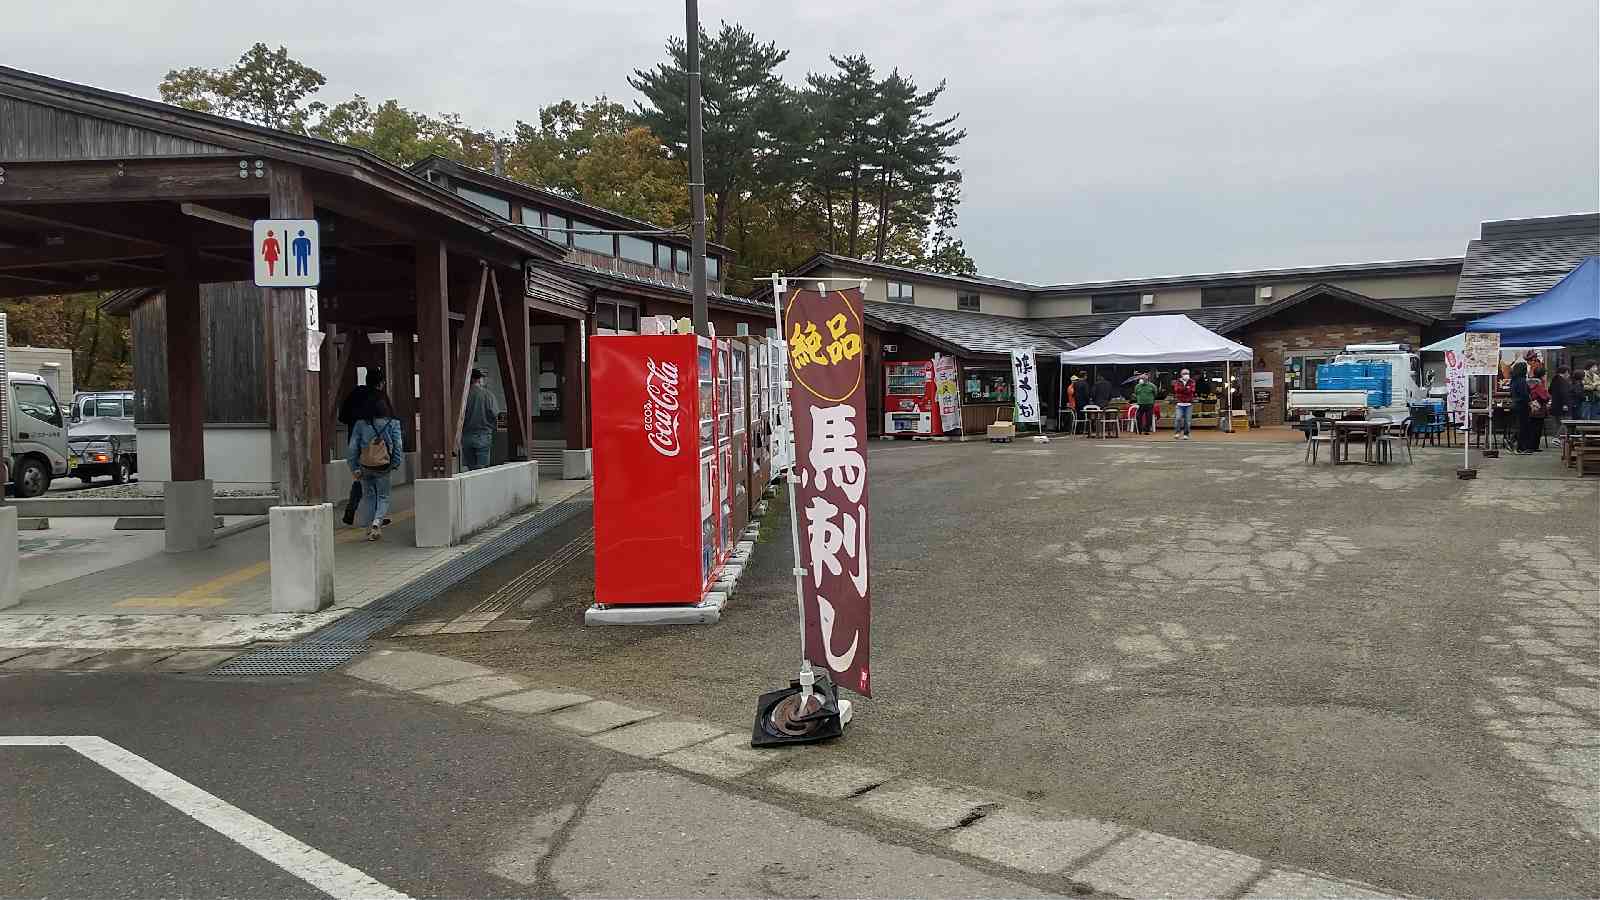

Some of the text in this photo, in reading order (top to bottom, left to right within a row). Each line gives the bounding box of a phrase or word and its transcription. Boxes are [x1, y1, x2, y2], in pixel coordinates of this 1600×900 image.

[308, 290, 317, 326] トイレ
[789, 312, 863, 370] 絶品
[646, 356, 680, 457] Coca-Cola
[801, 403, 868, 673] 馬刺し
